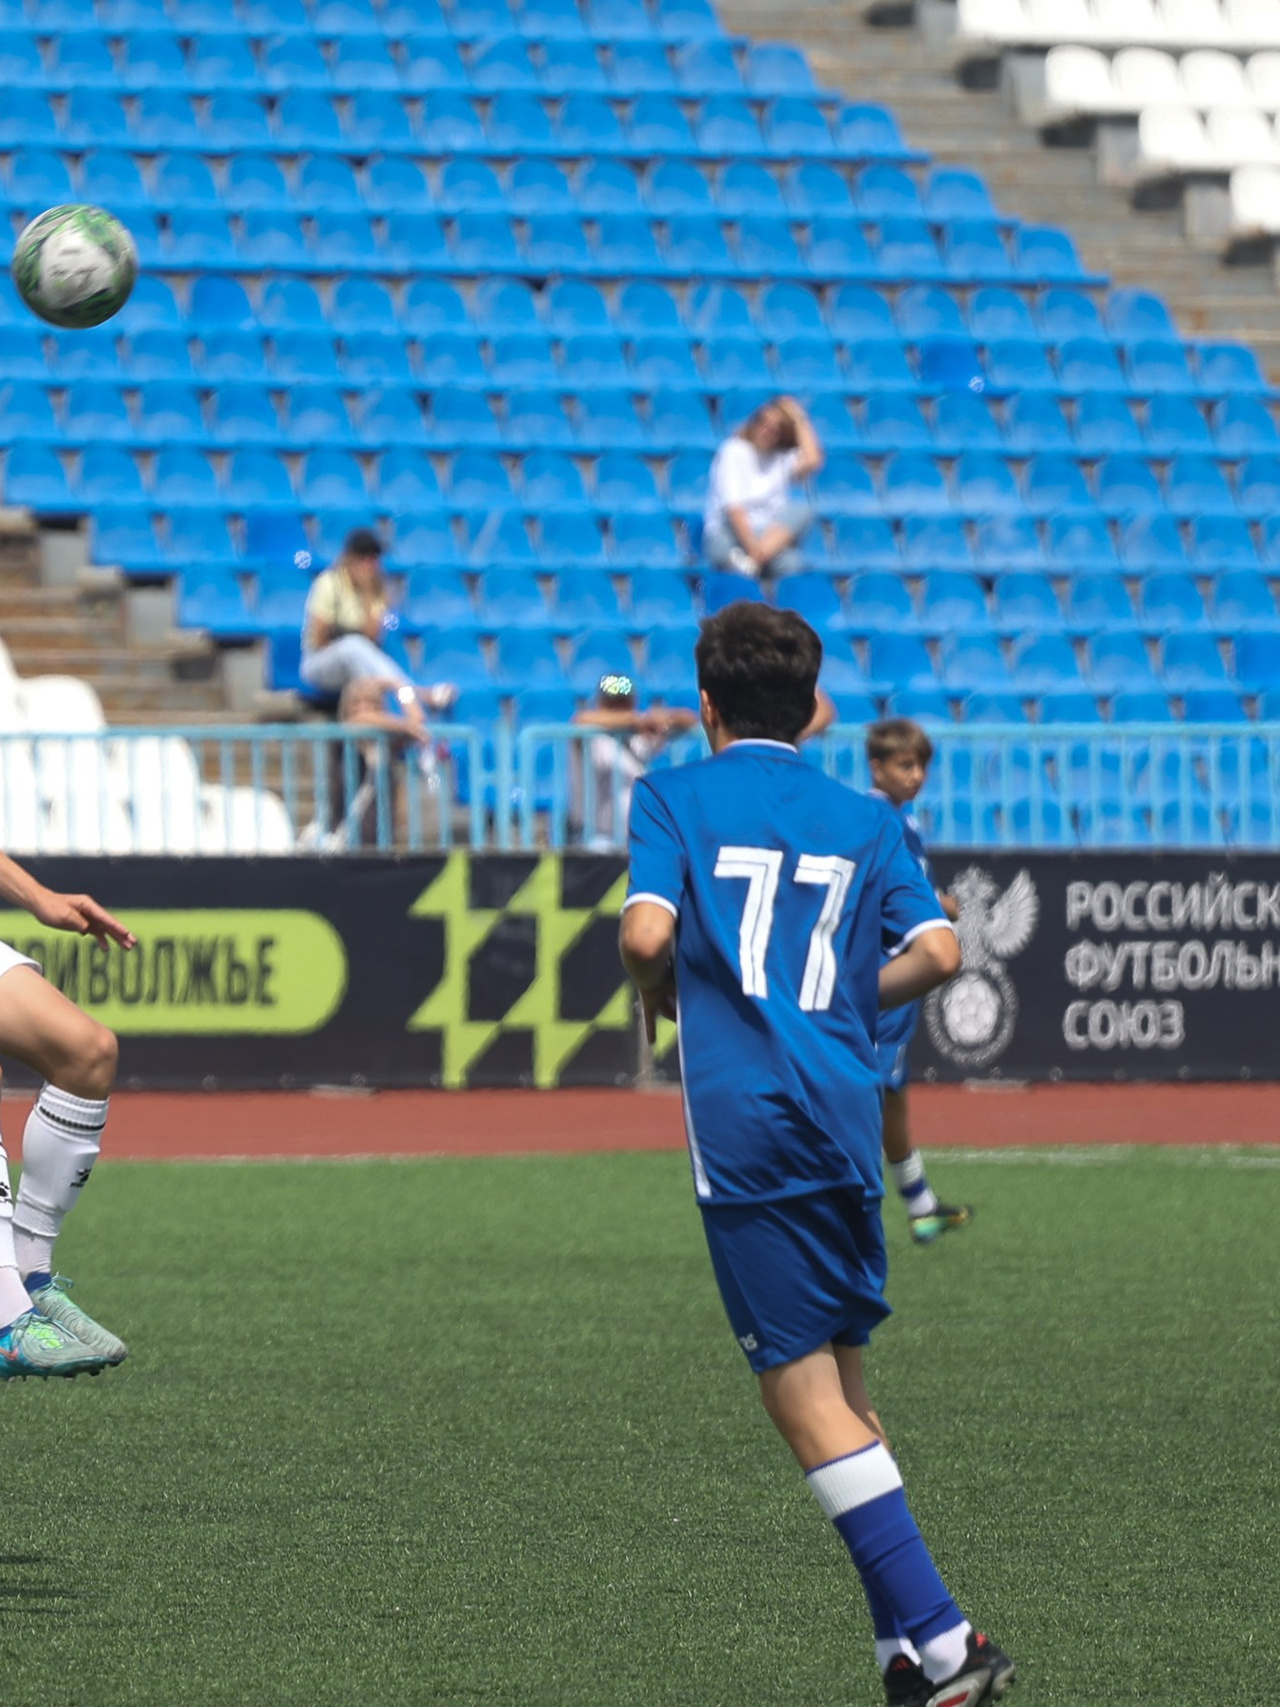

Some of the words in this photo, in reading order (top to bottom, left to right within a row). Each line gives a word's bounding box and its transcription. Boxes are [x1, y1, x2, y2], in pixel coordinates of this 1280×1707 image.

[713, 845, 857, 1012] 77
[1066, 871, 1280, 931] РОССИЙСК
[2, 935, 278, 1005] РИВОЛЖЬЕ
[1065, 938, 1280, 992] ФУТБОЛЬН
[1063, 1000, 1185, 1049] СОЮЗ
